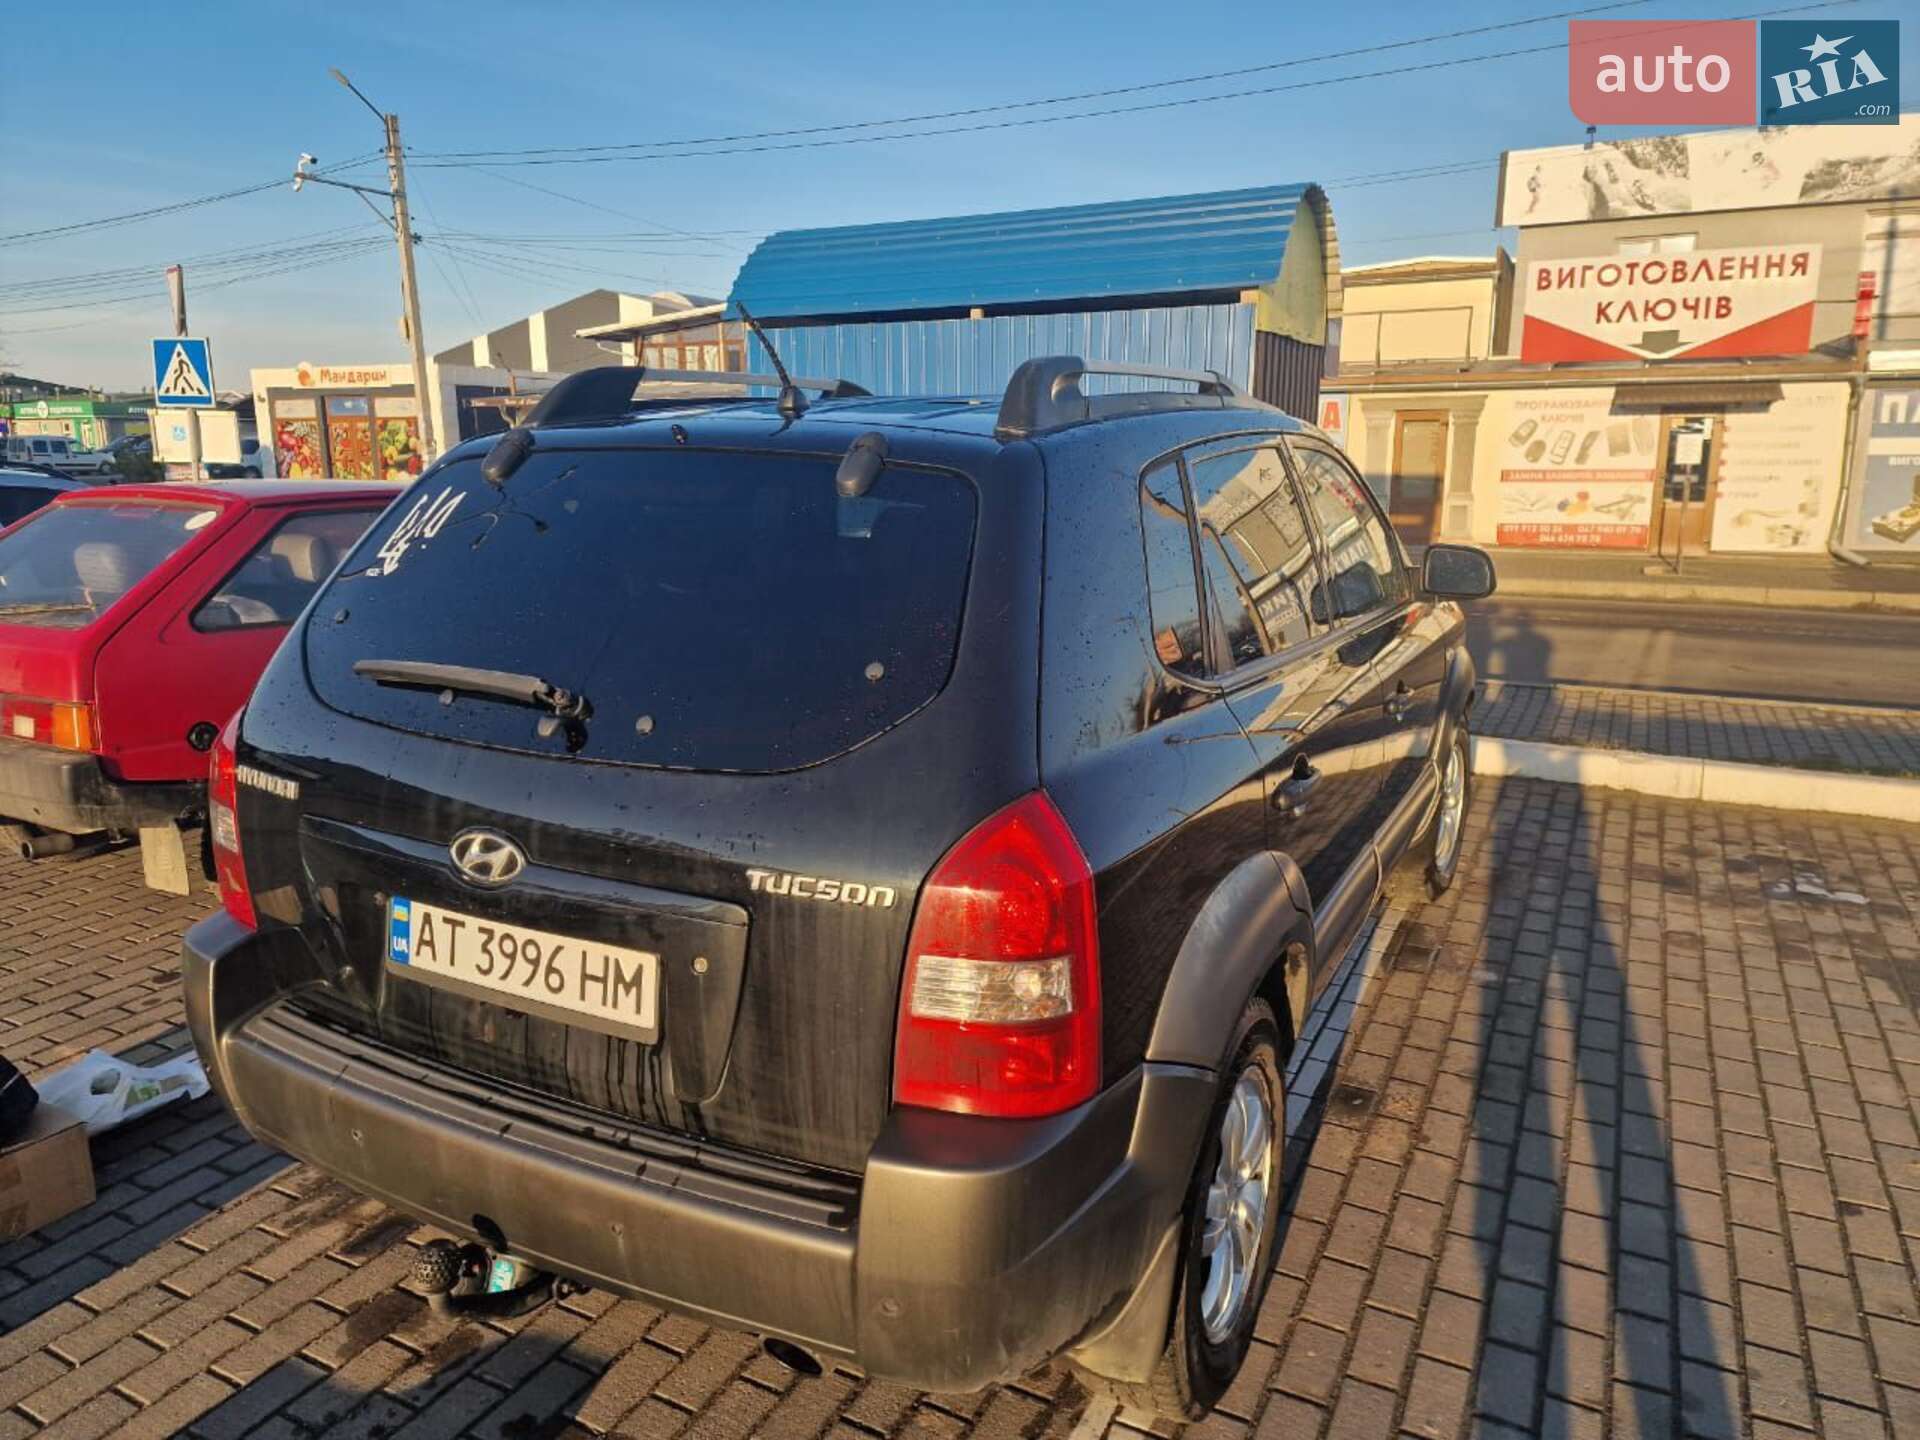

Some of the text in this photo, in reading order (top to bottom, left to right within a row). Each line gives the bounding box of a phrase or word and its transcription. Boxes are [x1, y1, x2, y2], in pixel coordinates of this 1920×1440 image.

[1536, 252, 1810, 291] ВИГОТОВЛЕННЯ
[1595, 296, 1733, 324] КЛЮЧІВ
[320, 367, 387, 384] Мандарин
[745, 868, 896, 908] TUCSON
[393, 935, 409, 953] UA
[415, 911, 644, 1015] AT 3996 HM
